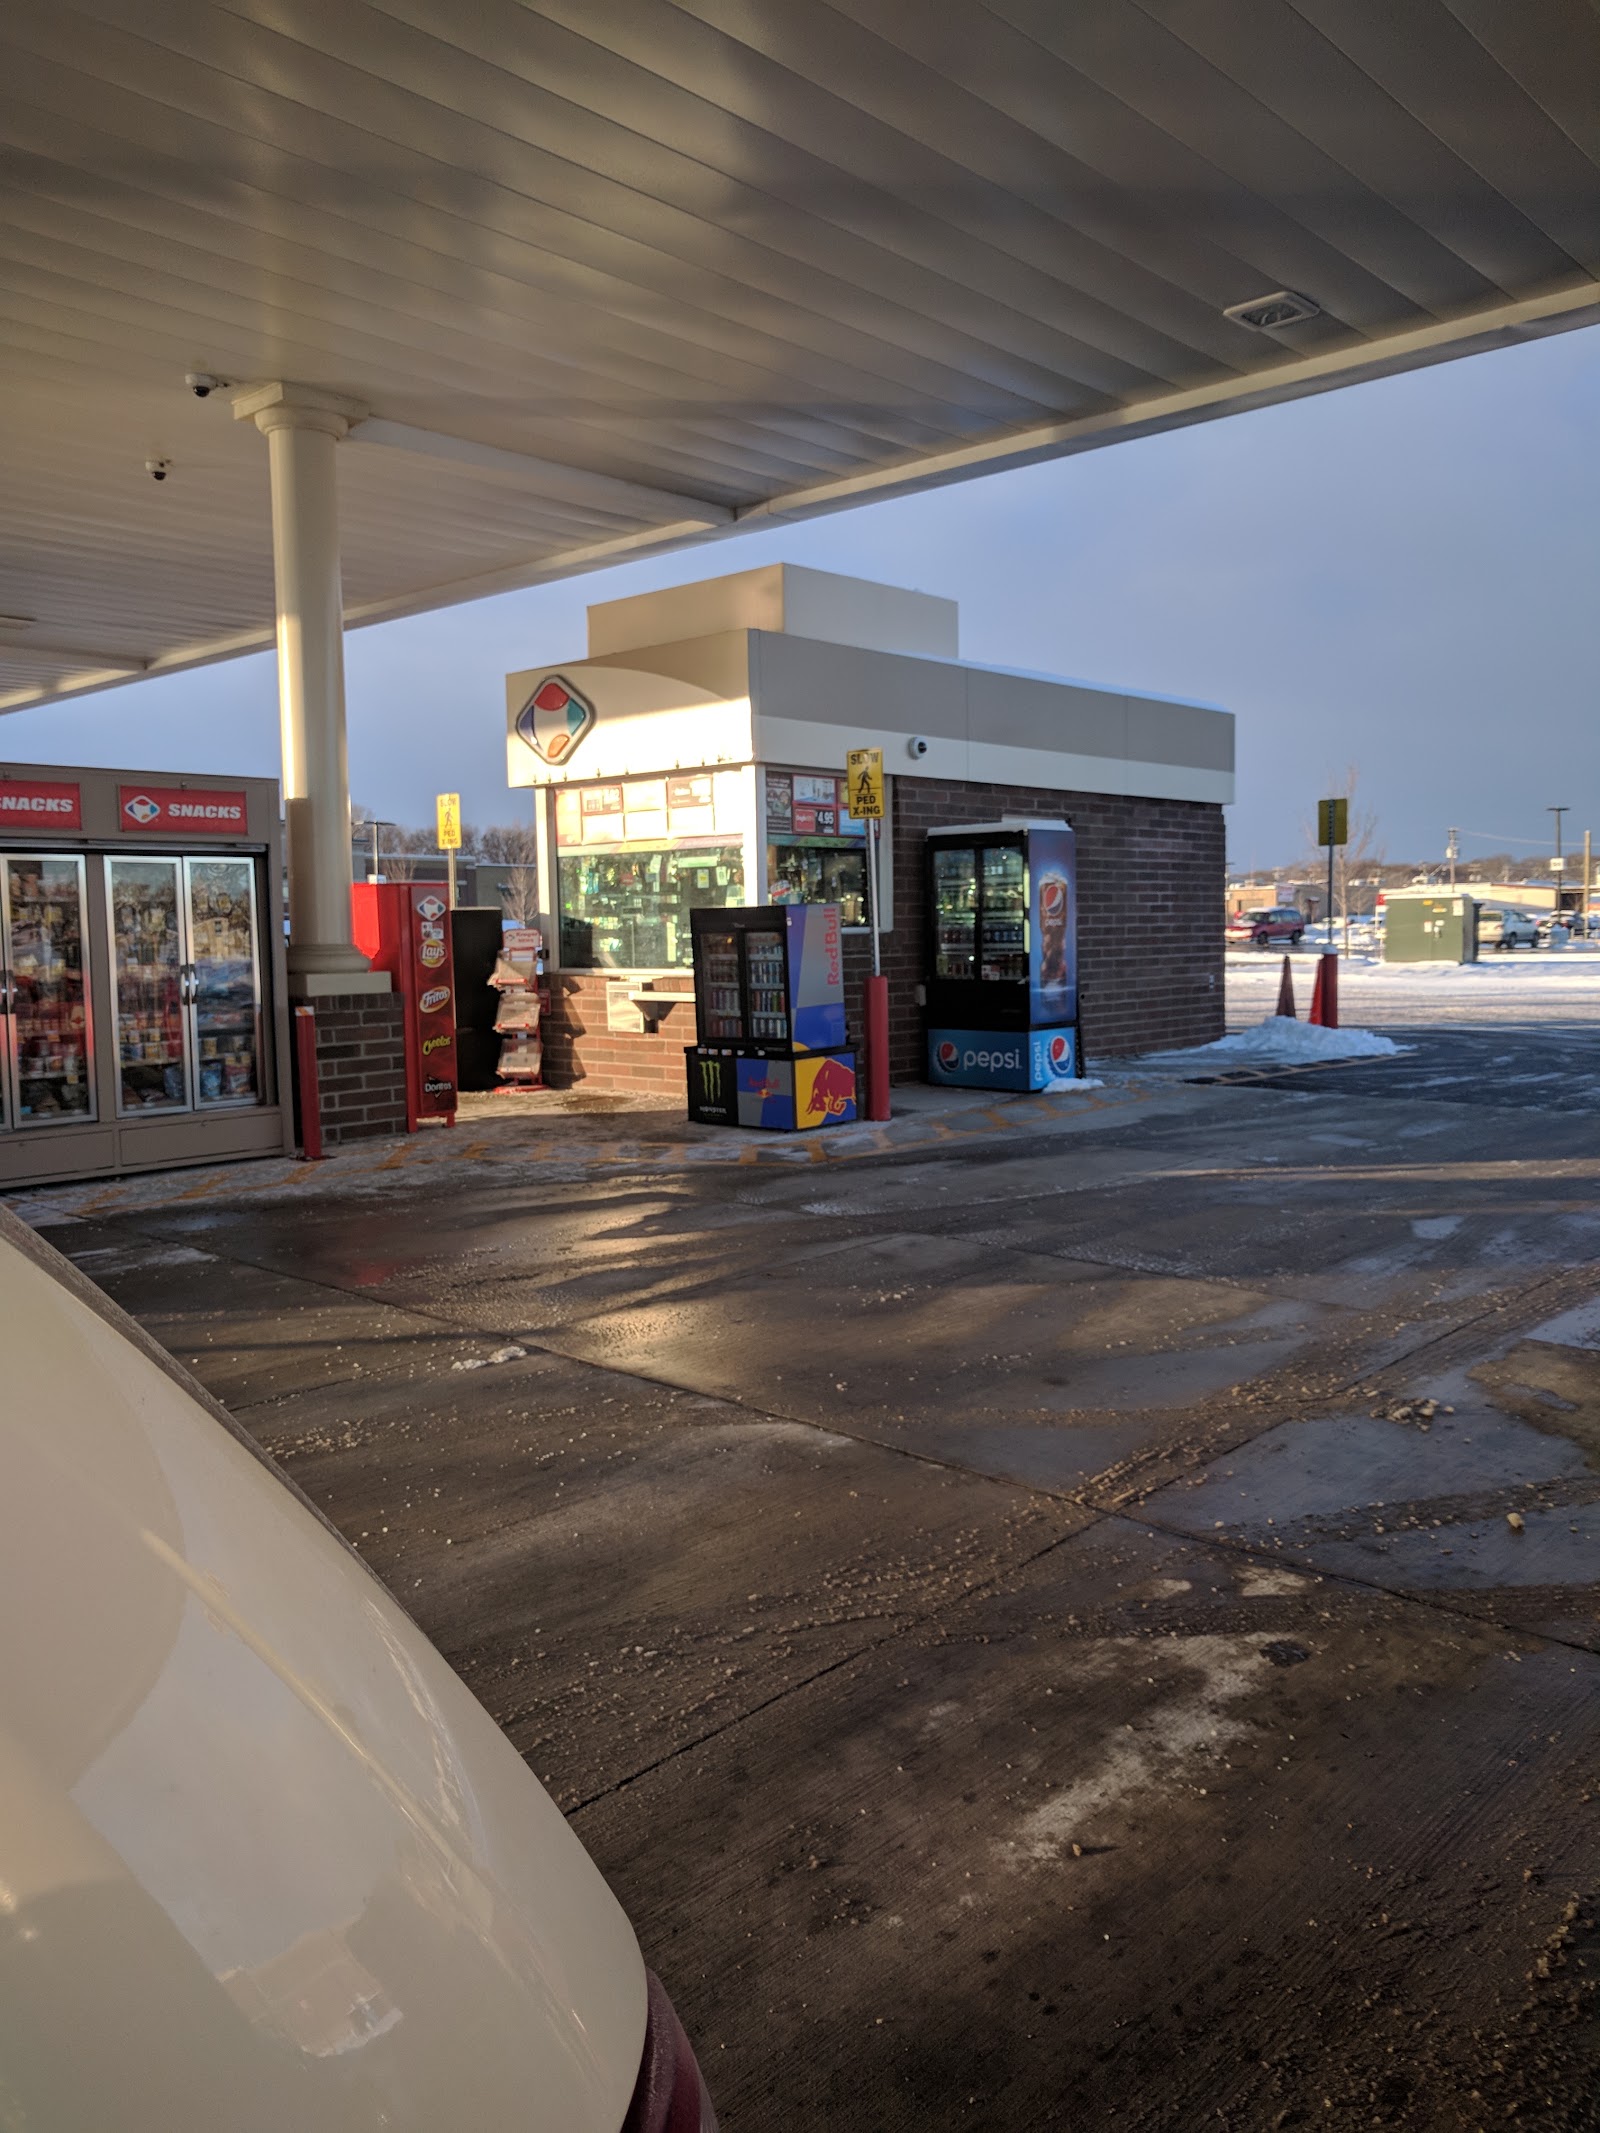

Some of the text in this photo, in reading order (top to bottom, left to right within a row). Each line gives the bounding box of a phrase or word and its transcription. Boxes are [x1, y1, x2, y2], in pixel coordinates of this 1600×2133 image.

[0, 796, 74, 813] NACKS
[856, 796, 876, 804] PED
[168, 803, 242, 820] SNACKS
[852, 805, 881, 816] X-ING
[424, 989, 450, 1008] Fritos
[963, 1049, 1020, 1073] pepsi
[1033, 1041, 1043, 1081] pepsi
[424, 1082, 452, 1093] Doritos
